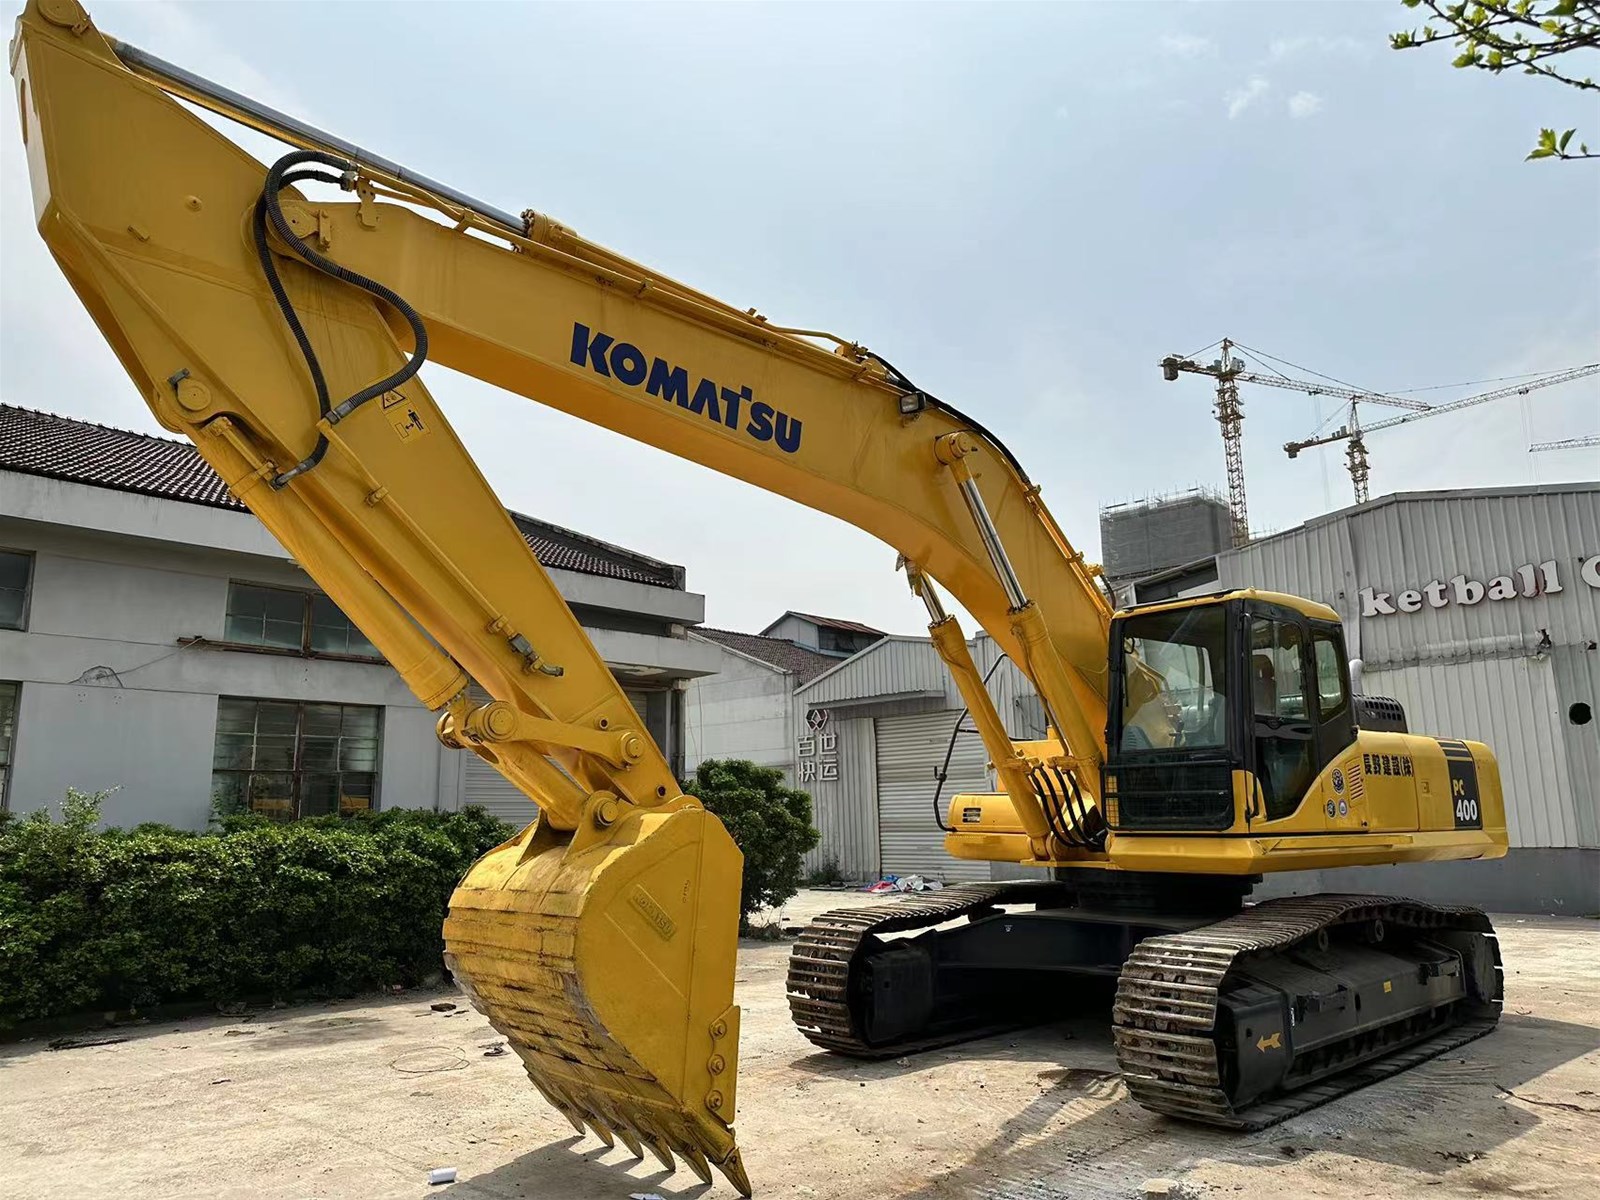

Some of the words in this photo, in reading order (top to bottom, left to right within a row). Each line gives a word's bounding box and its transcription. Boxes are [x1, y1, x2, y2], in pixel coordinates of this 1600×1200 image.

[570, 321, 803, 453] KOMATSU
[1358, 560, 1563, 617] ketball
[798, 733, 837, 757] 百世
[797, 759, 838, 782] 快运
[1452, 779, 1465, 796] PC
[1456, 799, 1478, 821] 400
